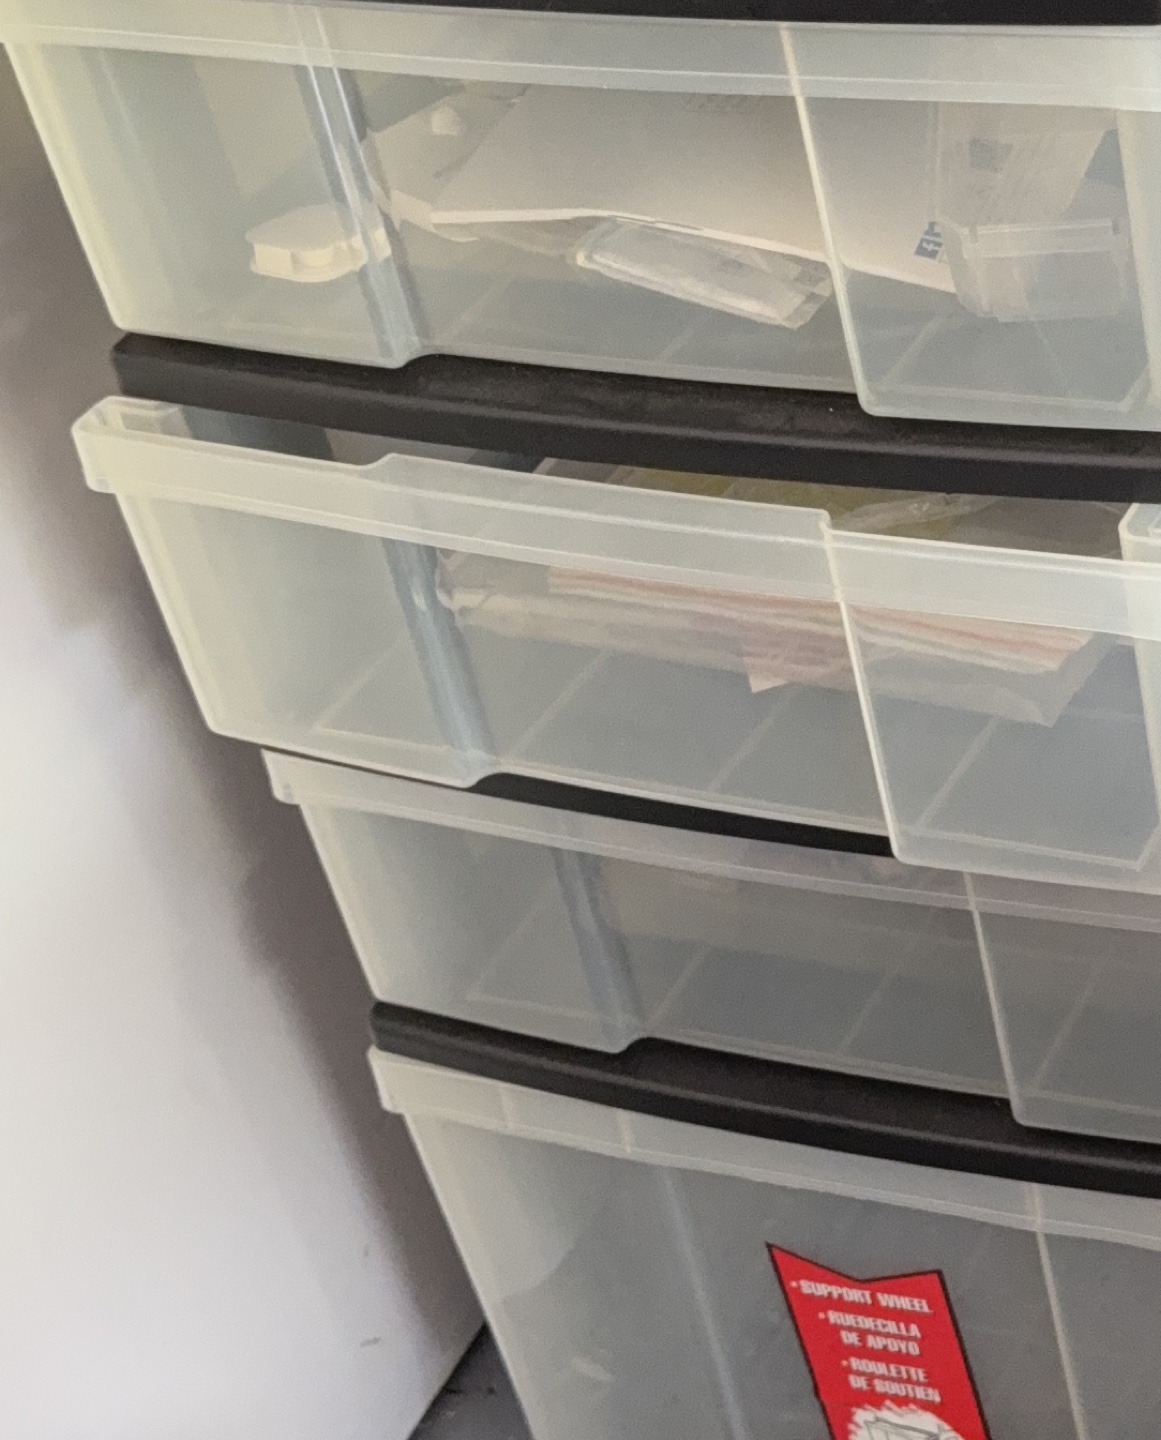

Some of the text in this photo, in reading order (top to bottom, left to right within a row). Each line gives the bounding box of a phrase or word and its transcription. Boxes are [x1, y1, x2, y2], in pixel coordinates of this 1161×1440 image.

[799, 1279, 933, 1314] SUPPORT WHEEL
[827, 1310, 922, 1339] RUEDECILLA
[840, 1330, 921, 1356] DE APOYO
[849, 1356, 929, 1383] ROULETTE
[848, 1374, 942, 1404] DE SOUTIEN
